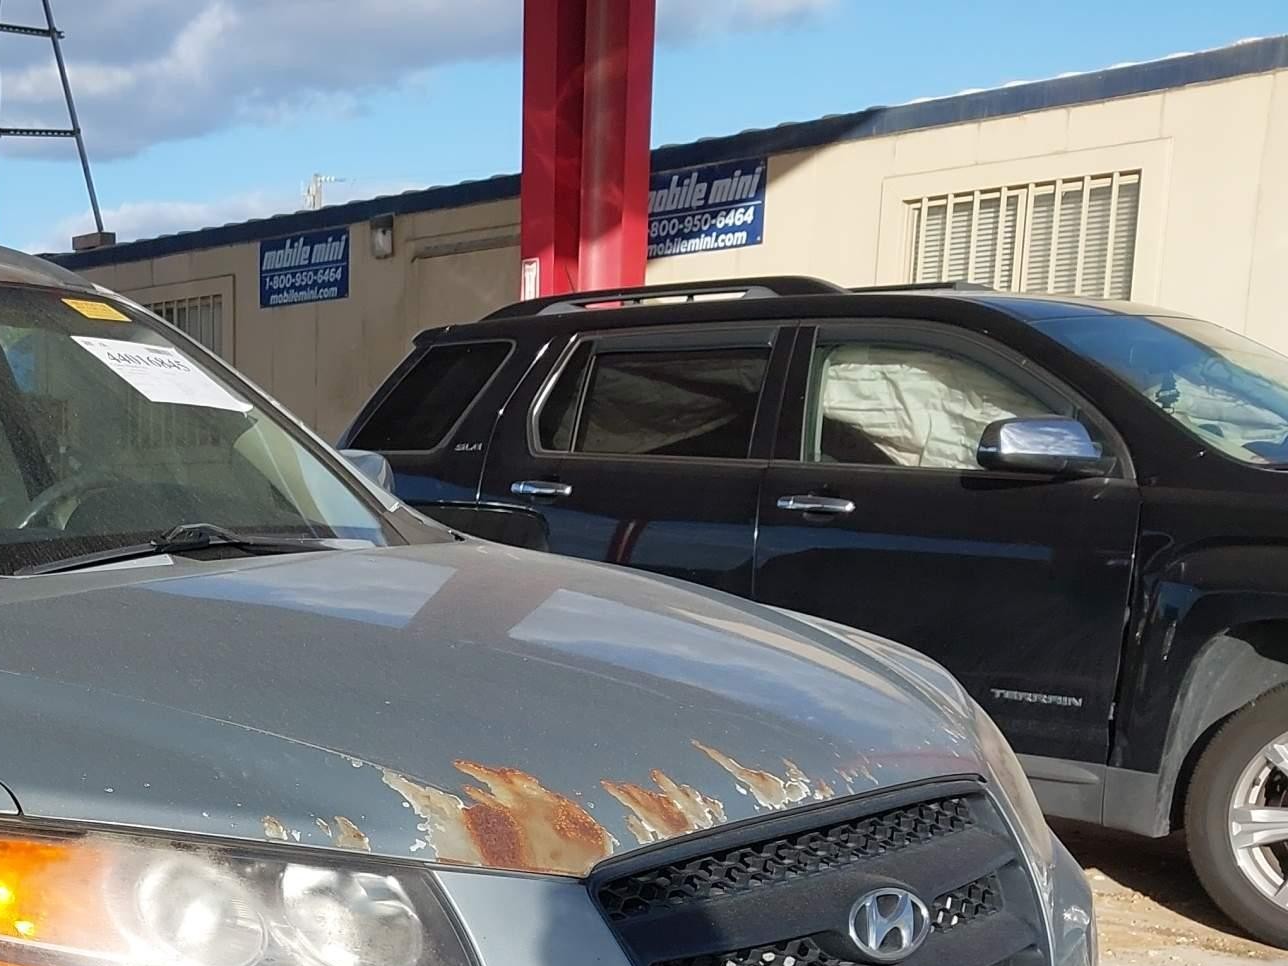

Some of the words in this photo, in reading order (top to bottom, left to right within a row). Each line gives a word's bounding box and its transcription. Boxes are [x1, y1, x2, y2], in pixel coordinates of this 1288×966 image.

[708, 167, 763, 204] mini
[262, 237, 311, 271] mobile
[311, 235, 347, 264] mini
[265, 267, 342, 290] 1-800-950-6464
[269, 286, 339, 305] mobilemini.com
[989, 687, 1084, 708] TERRAIN
